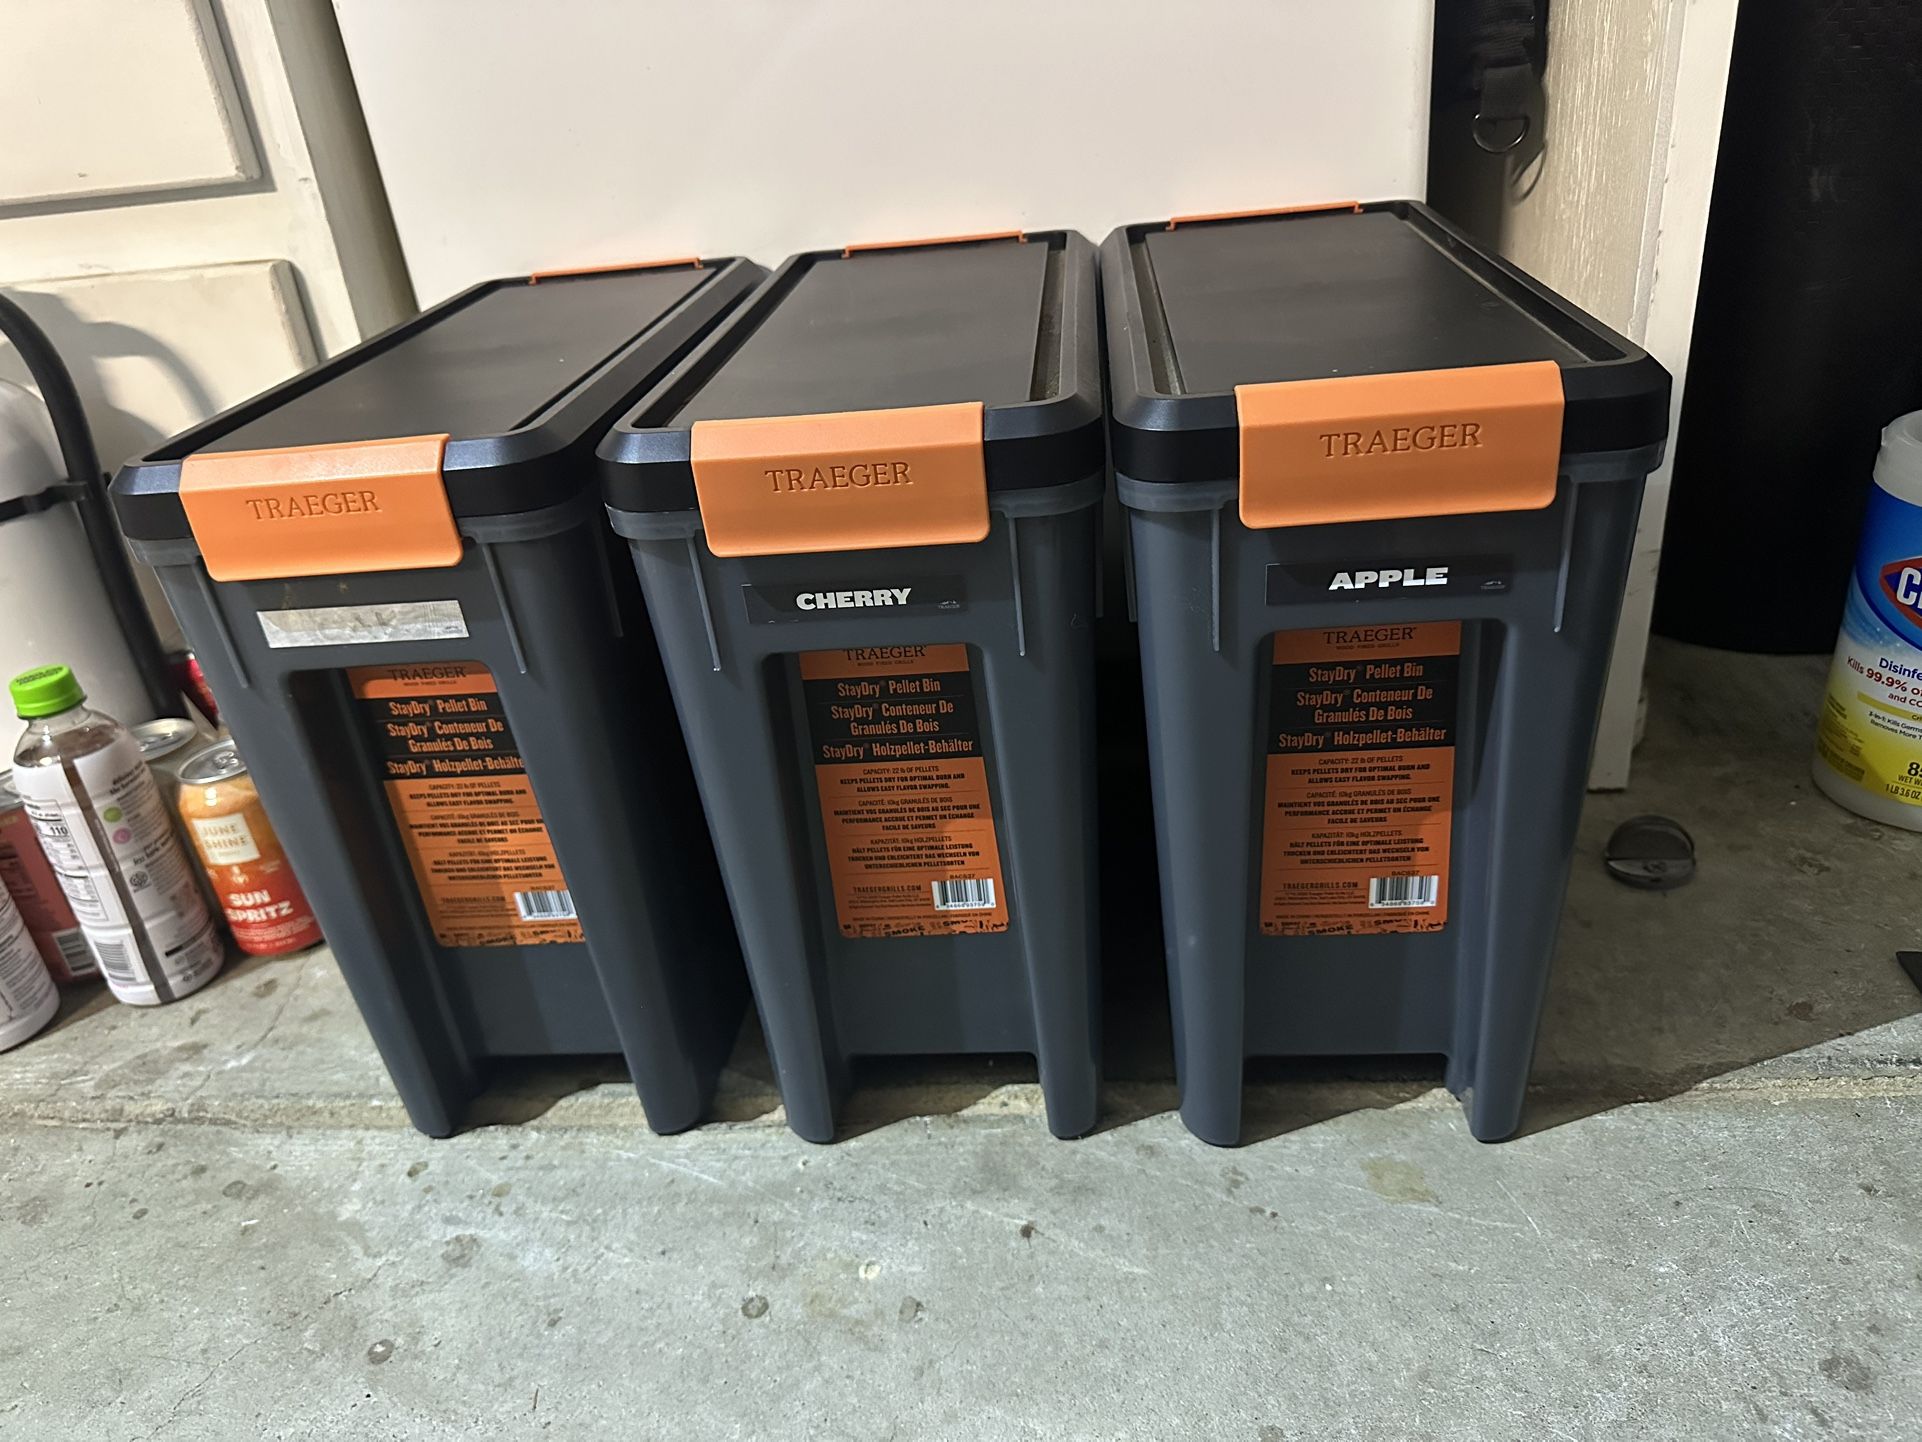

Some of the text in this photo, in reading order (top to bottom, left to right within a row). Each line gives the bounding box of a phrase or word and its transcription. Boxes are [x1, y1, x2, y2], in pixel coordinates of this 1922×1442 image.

[1320, 423, 1482, 457] TRAEGER
[765, 462, 913, 493] TRAEGER
[247, 490, 382, 520] TRAEGER
[1329, 567, 1448, 590] APPLE
[796, 588, 912, 610] CHERRY
[1324, 627, 1417, 644] TRAEGER
[843, 646, 927, 661] TRAEGER
[388, 667, 466, 681] TRAEGER
[1365, 665, 1400, 679] Pellet
[1404, 663, 1424, 677] Bin
[1847, 656, 1864, 674] Kills
[1866, 668, 1907, 692] 99.9%
[889, 680, 920, 694] Pellet
[923, 678, 941, 691] Bin
[1353, 687, 1414, 704] Conteneur
[1417, 685, 1433, 700] De
[1888, 693, 1907, 703] and
[437, 699, 467, 712] Pellet
[468, 698, 487, 711] Bin
[882, 702, 936, 717] Conteneur
[939, 700, 954, 713] De
[1314, 706, 1413, 724] Granulés De Bois
[434, 721, 487, 734] Conteneur
[488, 719, 504, 732] De
[851, 718, 939, 736] Granulés De Bois
[1899, 730, 1917, 738] More
[408, 737, 494, 752] Granulés De Bois
[1334, 727, 1447, 747] Holzpellet-Behälter
[872, 738, 973, 757] Holzpellet-Behälter
[433, 757, 524, 773] Holzpellet-Behälte
[1898, 774, 1913, 783] WET
[1886, 784, 1889, 792] 1
[1890, 785, 1899, 794] LB
[1911, 791, 1921, 799] OZ
[50, 827, 68, 835] 110
[202, 824, 237, 836] JUNE
[204, 837, 248, 849] SHINE
[228, 890, 270, 907] SUN
[226, 901, 294, 923] SPRITZ
